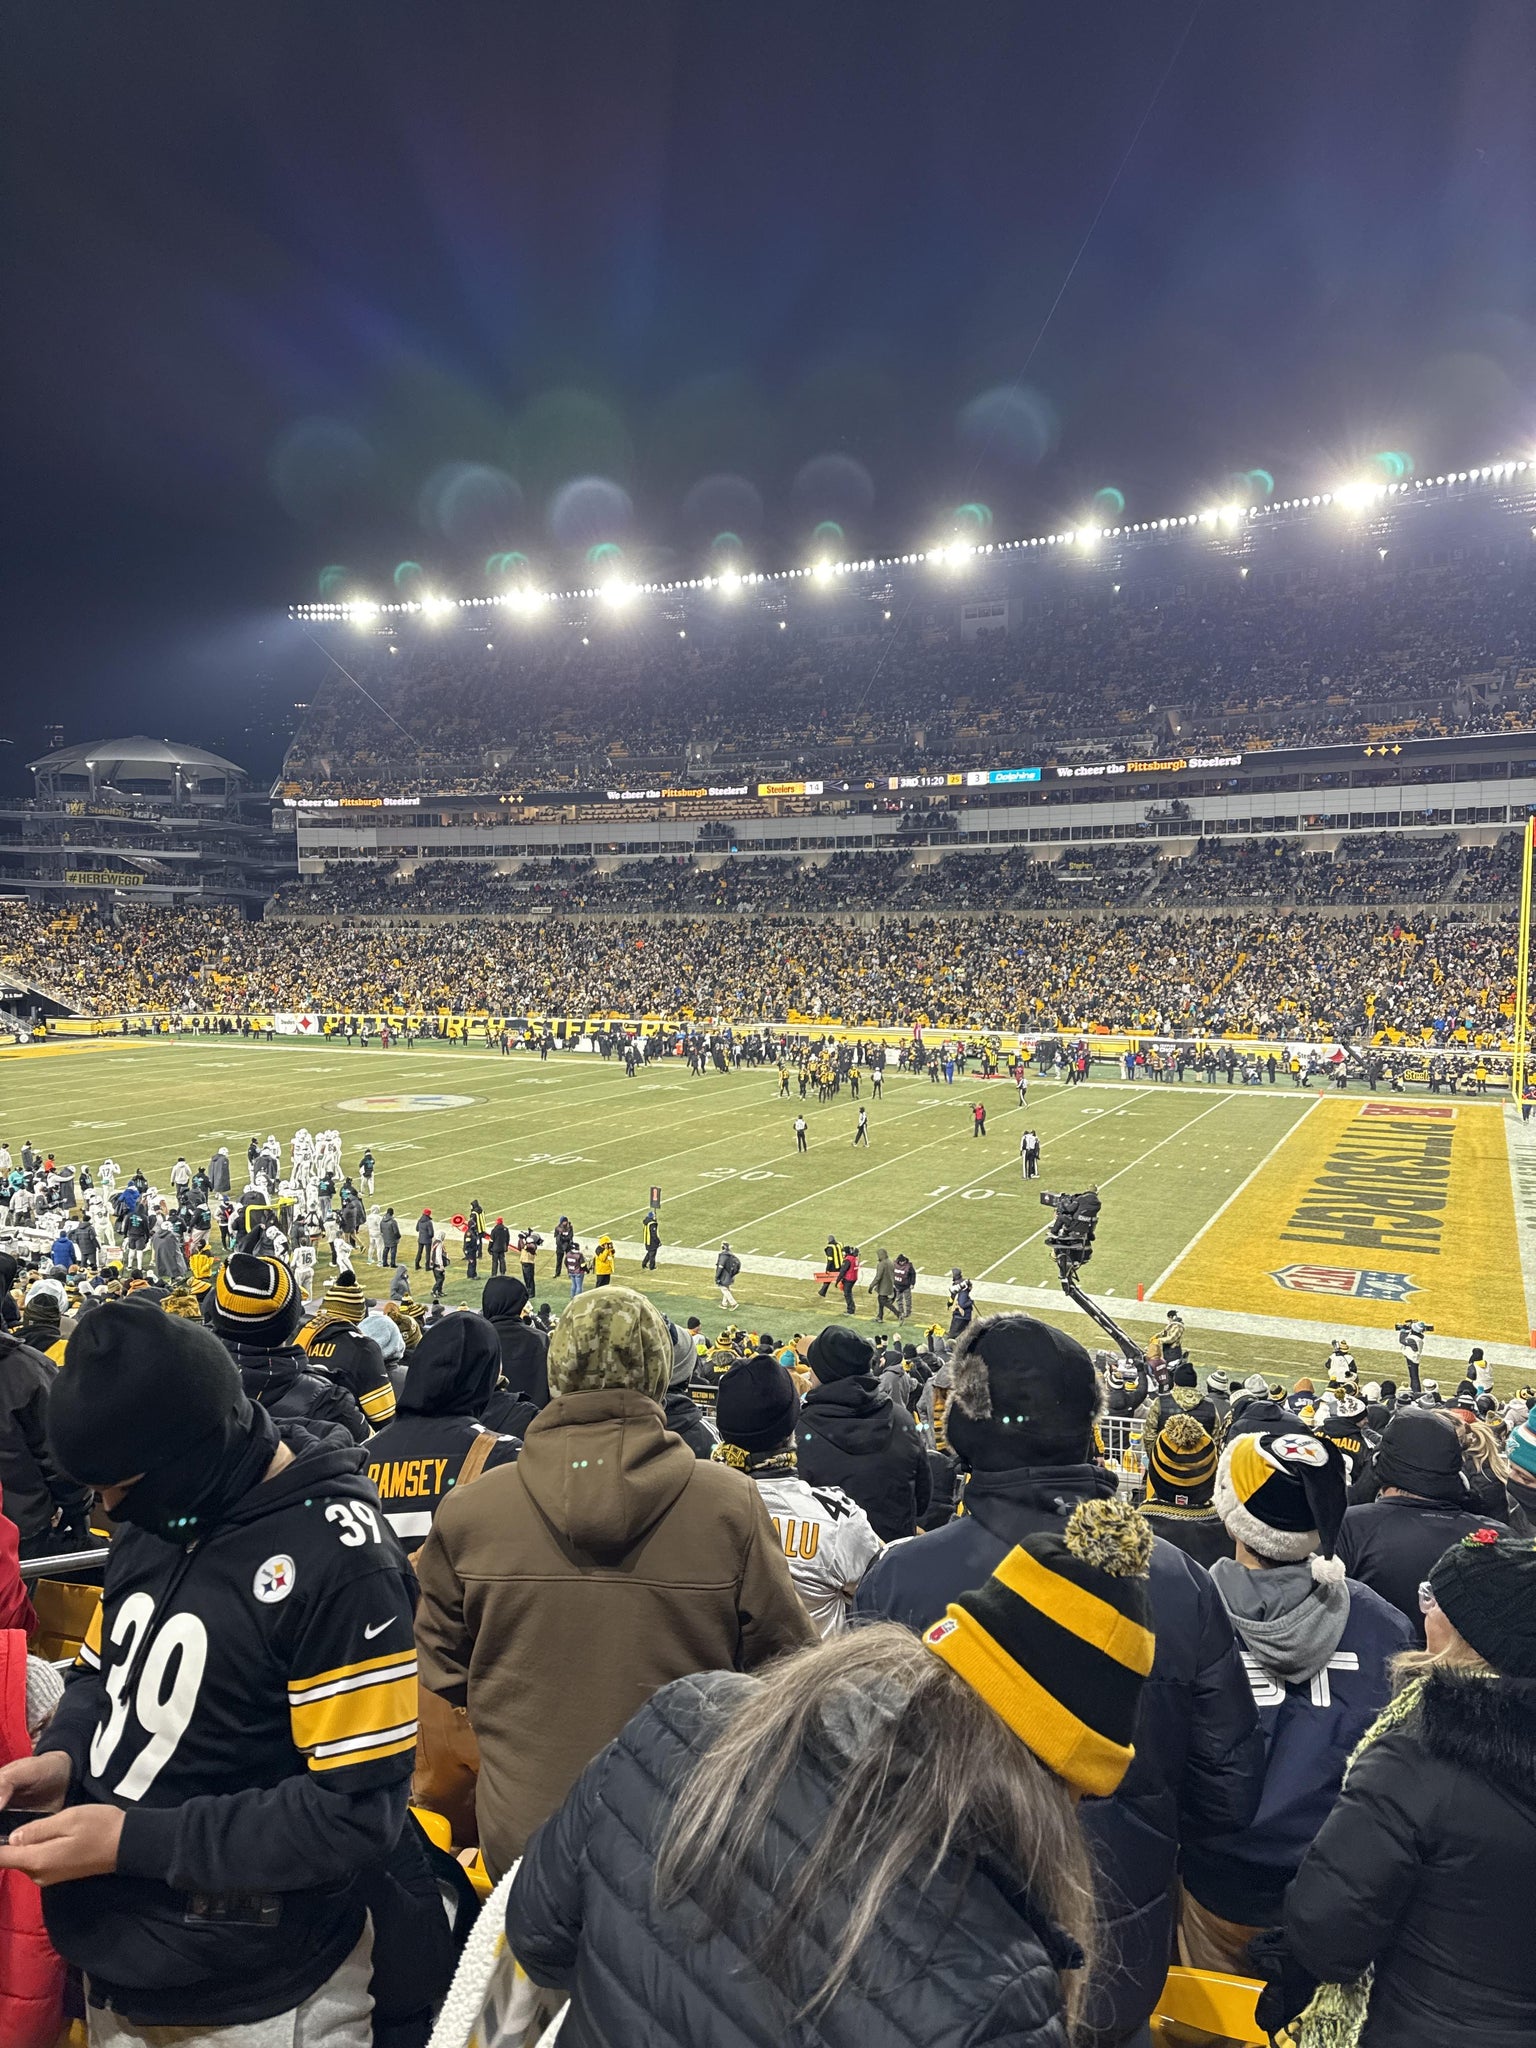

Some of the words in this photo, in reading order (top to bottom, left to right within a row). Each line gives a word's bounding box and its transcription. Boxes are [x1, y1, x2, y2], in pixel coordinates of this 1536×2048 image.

[1057, 767, 1073, 777] We
[1074, 766, 1105, 776] cheer
[1106, 764, 1126, 774] the
[1126, 759, 1187, 773] Pittsburgh
[921, 776, 945, 786] 11:20
[994, 769, 1038, 782] Dolphins
[607, 791, 621, 800] We
[621, 790, 646, 799] cheer
[646, 789, 661, 799] the
[661, 788, 708, 799] Pittsburgh
[766, 784, 795, 795] Steelers
[808, 783, 820, 792] 14
[339, 798, 382, 808] Pittsburgh
[68, 873, 140, 887] #HEREWEGO
[513, 1153, 583, 1165] 30
[698, 1167, 775, 1181] 20
[923, 1185, 996, 1200] 10
[1279, 1119, 1457, 1255] PITTSBURGH
[652, 1188, 658, 1201] 1
[301, 1252, 313, 1265] 16
[1287, 1266, 1358, 1292] NFL
[308, 1343, 337, 1358] ALU
[367, 1458, 448, 1499] RAMSEY
[325, 1500, 382, 1547] 39
[772, 1517, 820, 1560] LU
[89, 1591, 208, 1802] 39
